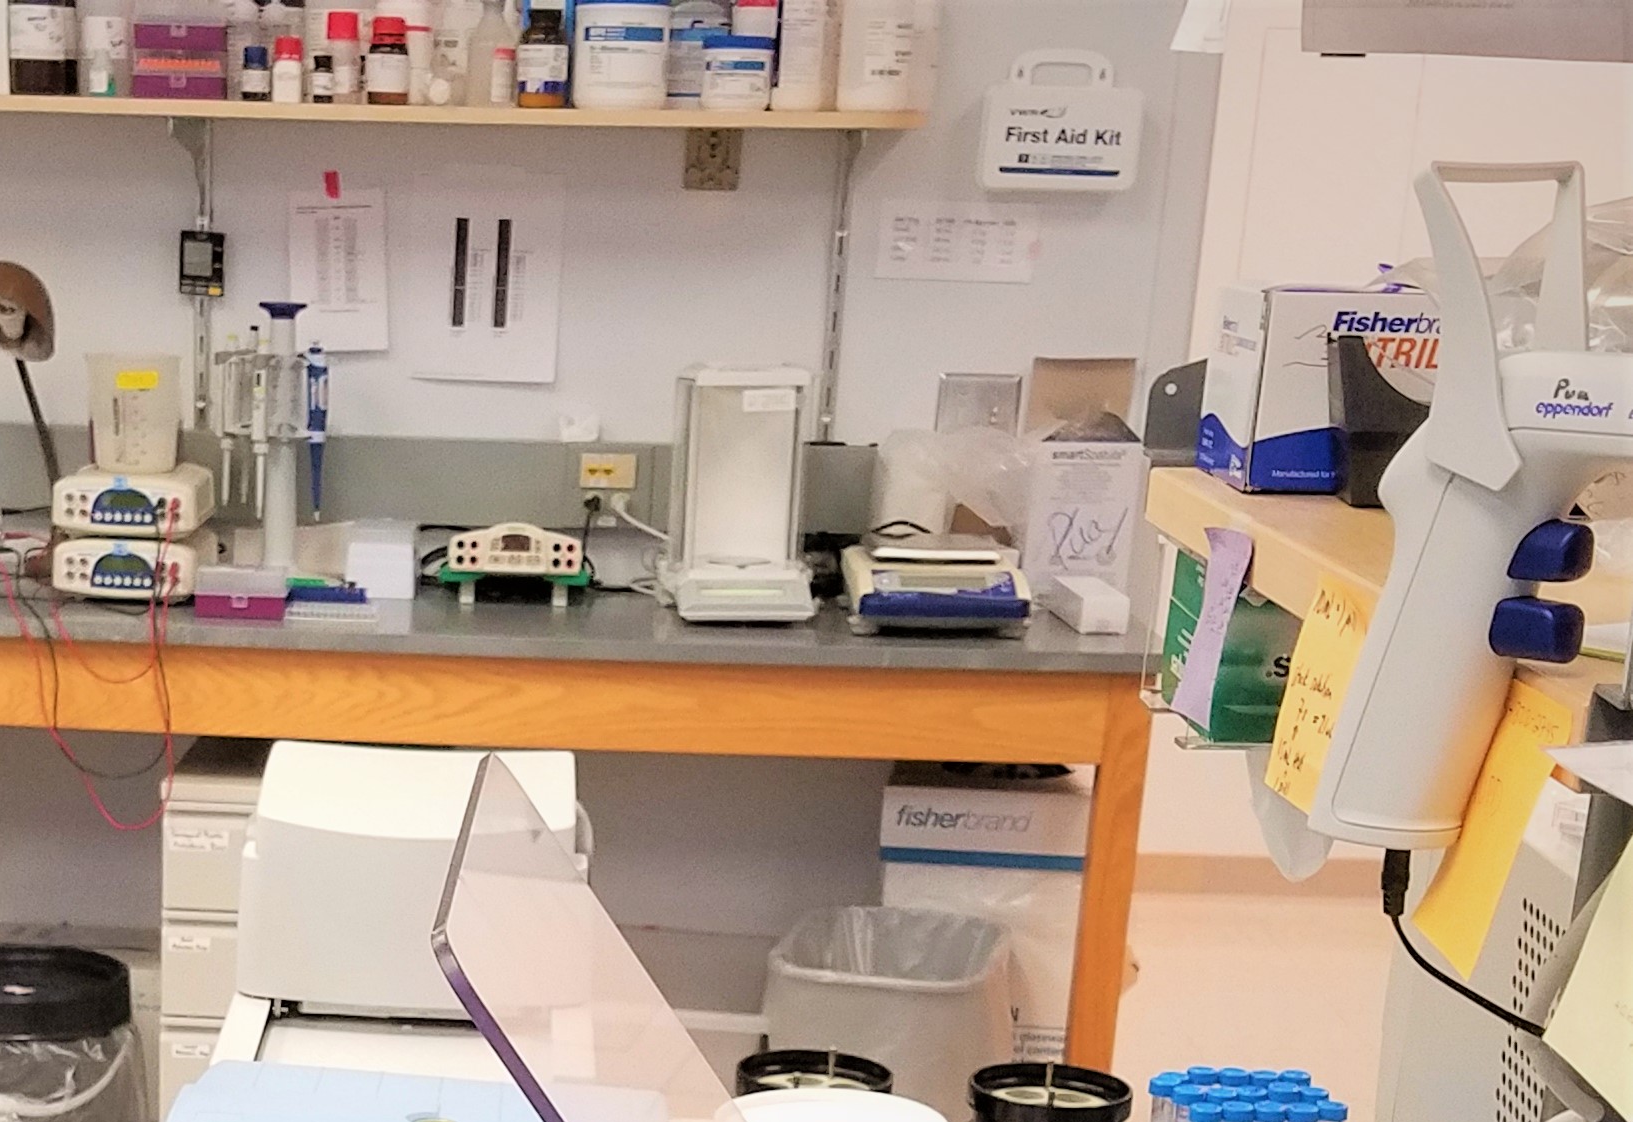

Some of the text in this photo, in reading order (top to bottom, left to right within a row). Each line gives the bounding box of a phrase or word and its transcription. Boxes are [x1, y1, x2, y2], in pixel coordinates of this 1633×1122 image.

[1005, 126, 1122, 145] First Aid Kit
[1333, 311, 1441, 335] Fisherbr
[1366, 336, 1438, 370] TRIL
[1536, 402, 1614, 419] eppendorf
[896, 804, 1034, 833] fisherbrand
